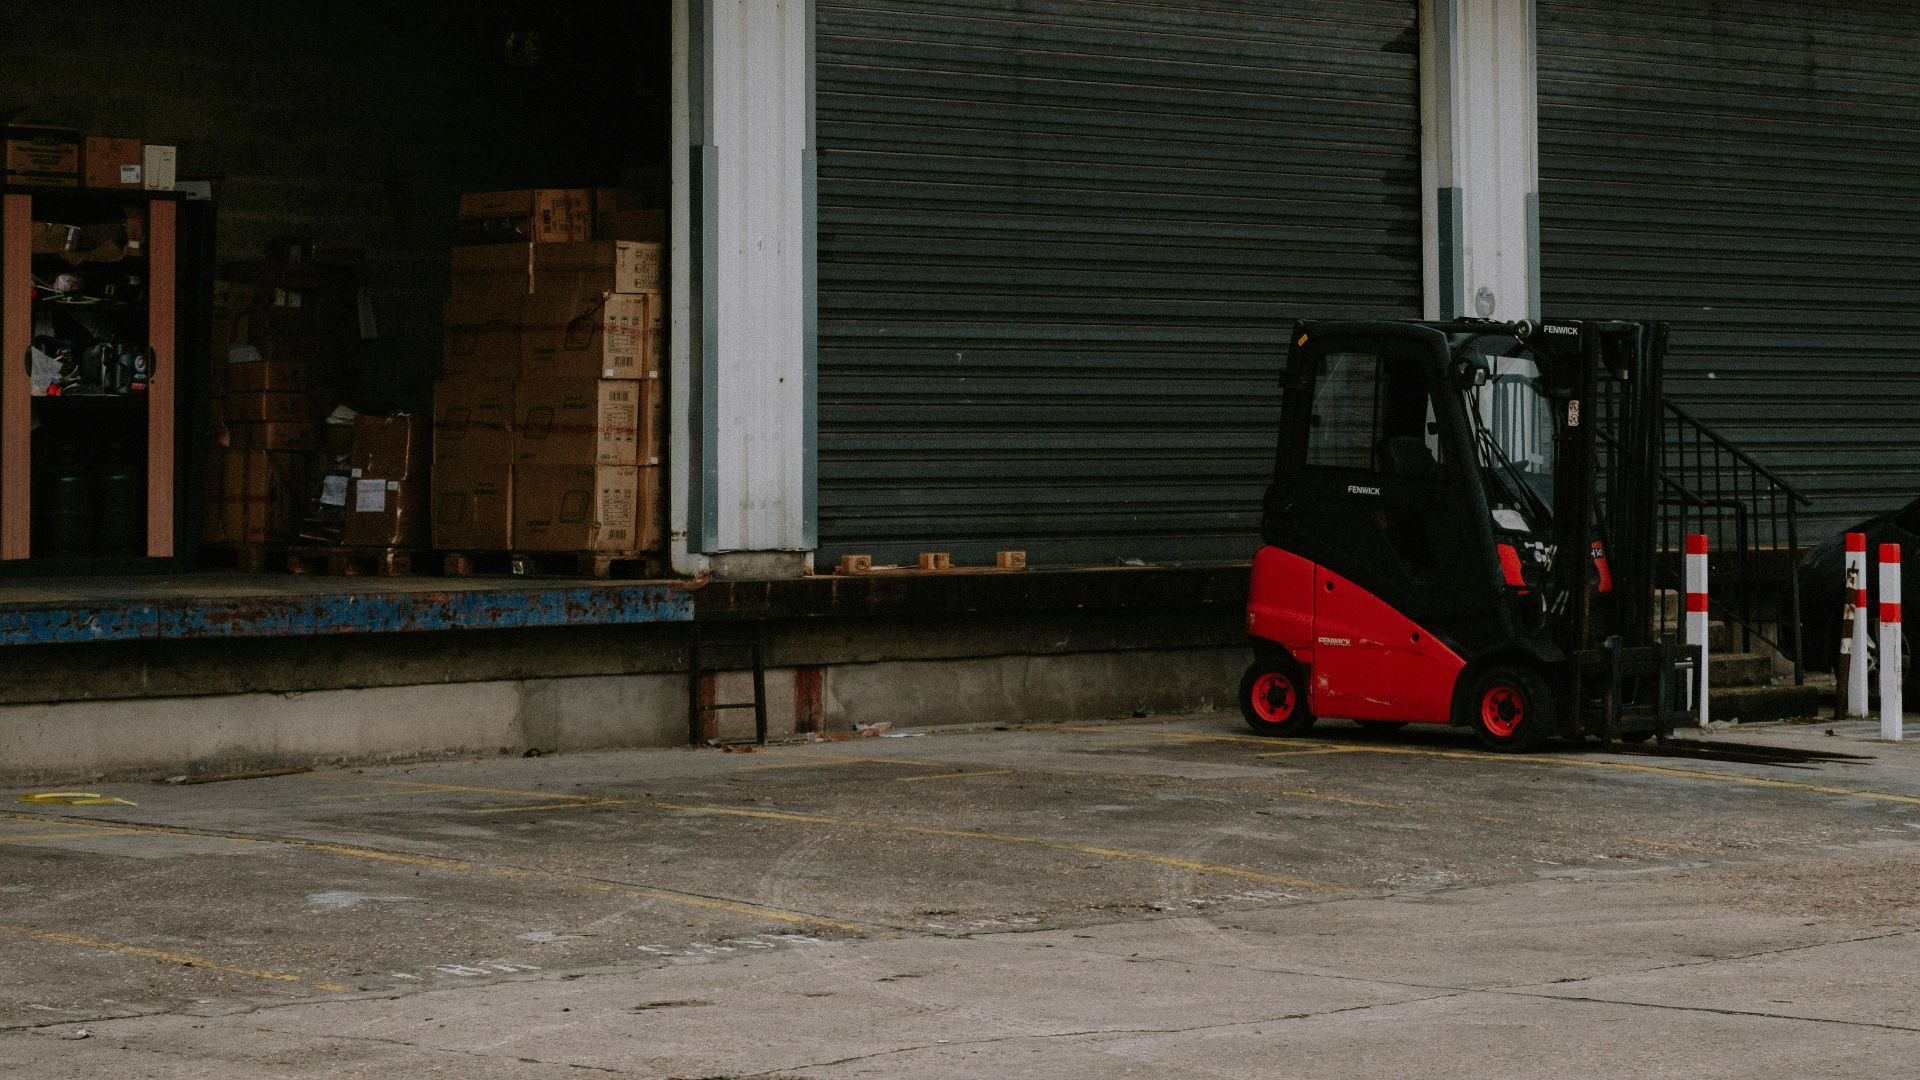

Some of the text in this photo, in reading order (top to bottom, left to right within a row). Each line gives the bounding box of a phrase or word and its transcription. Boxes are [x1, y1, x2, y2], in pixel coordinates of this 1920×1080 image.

[1543, 325, 1578, 336] FENWICK
[1348, 485, 1381, 496] FENWICK
[1318, 636, 1351, 647] FENWICK
